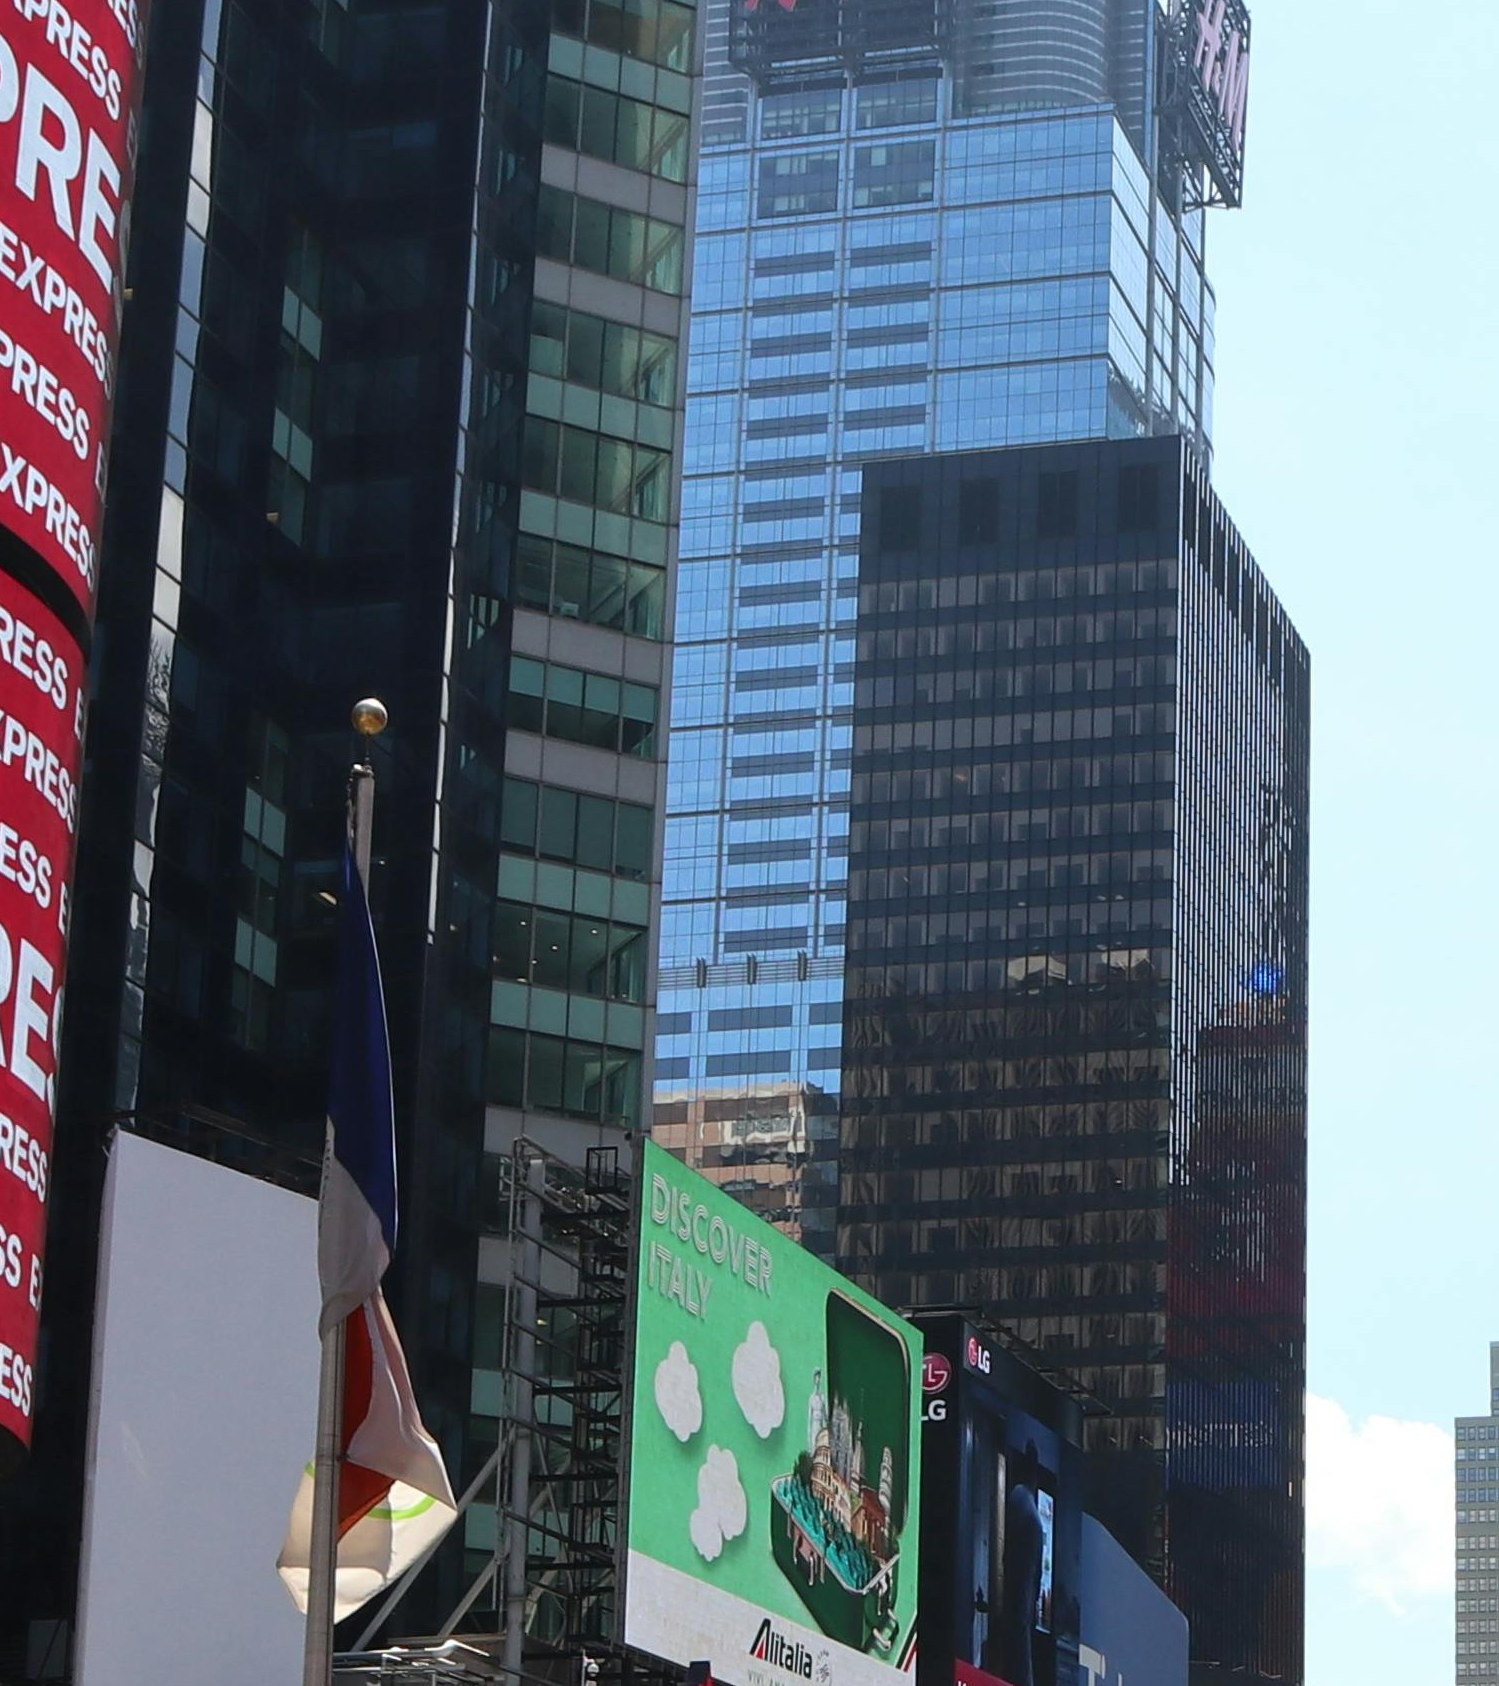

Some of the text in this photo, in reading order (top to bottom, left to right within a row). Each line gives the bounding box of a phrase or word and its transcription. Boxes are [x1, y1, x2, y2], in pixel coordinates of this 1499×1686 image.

[650, 1172, 773, 1297] DISCOVER
[648, 1241, 714, 1323] ITALY
[977, 1346, 991, 1375] LG
[750, 1617, 813, 1680] Alitalia
